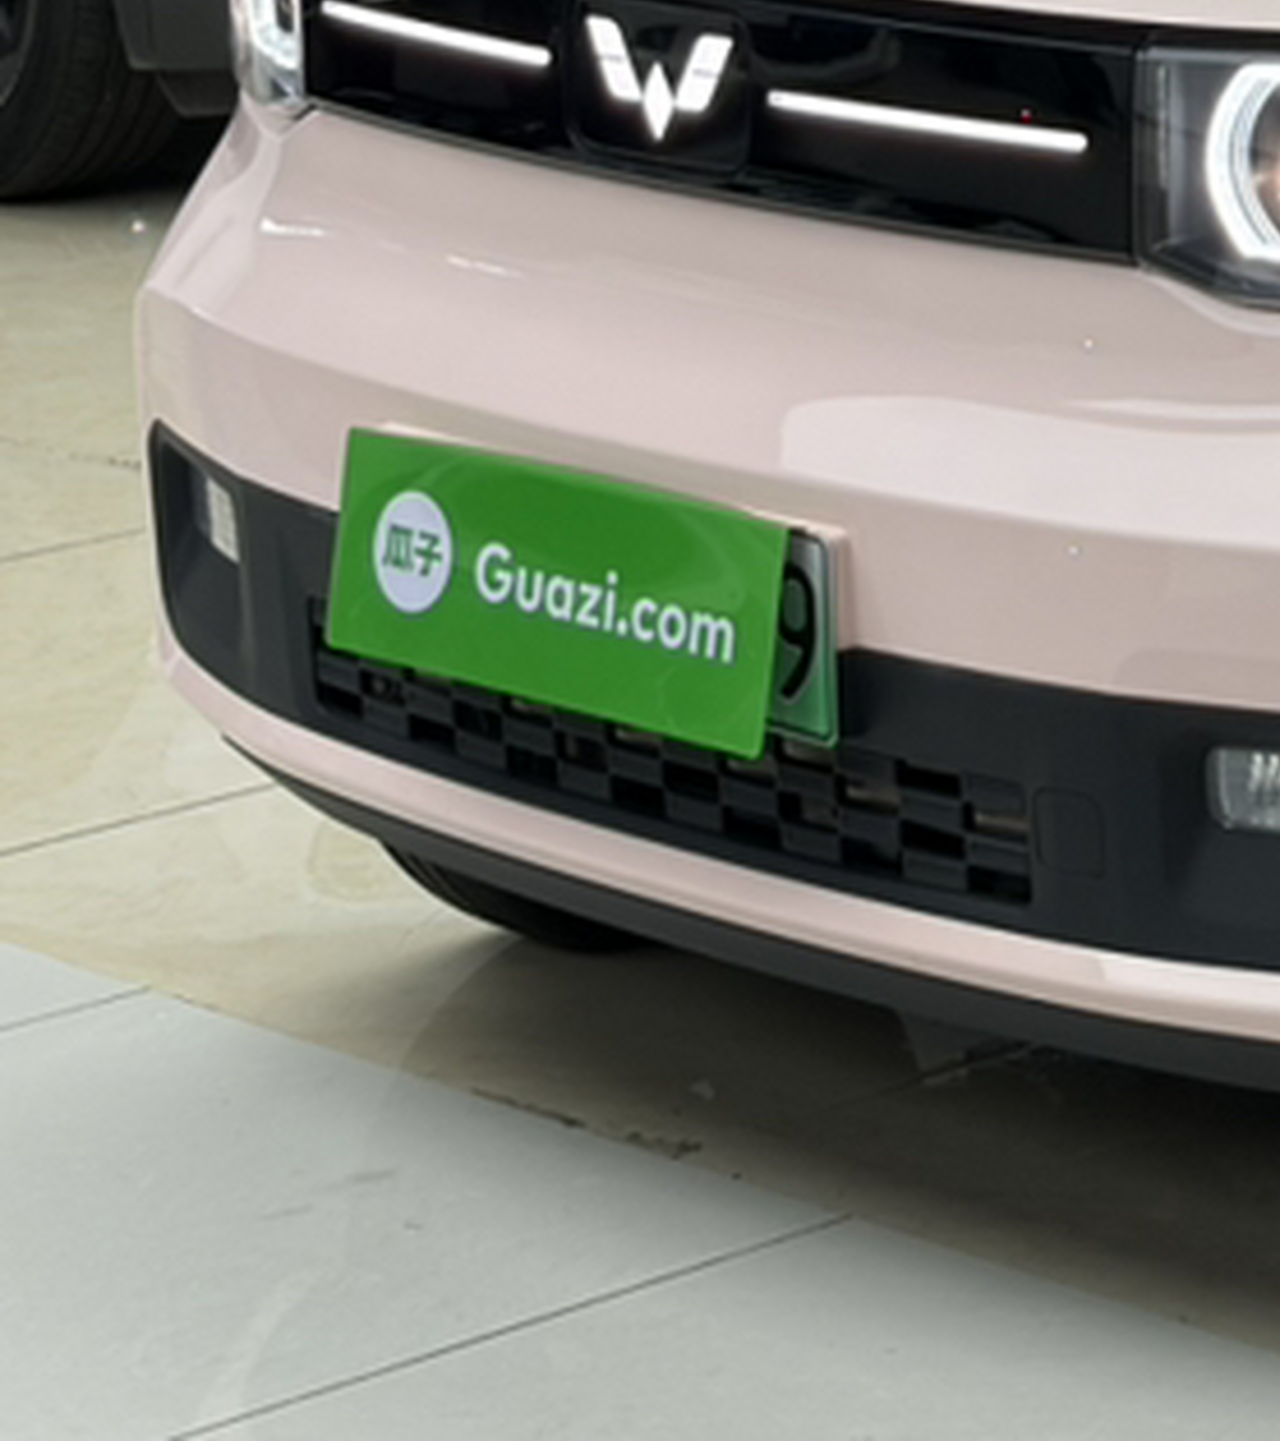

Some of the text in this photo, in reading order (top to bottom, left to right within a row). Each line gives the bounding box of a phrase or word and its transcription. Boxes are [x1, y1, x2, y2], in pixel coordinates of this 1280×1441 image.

[381, 522, 736, 663] 瓜子 Guazi.com
[778, 562, 817, 700] 9
